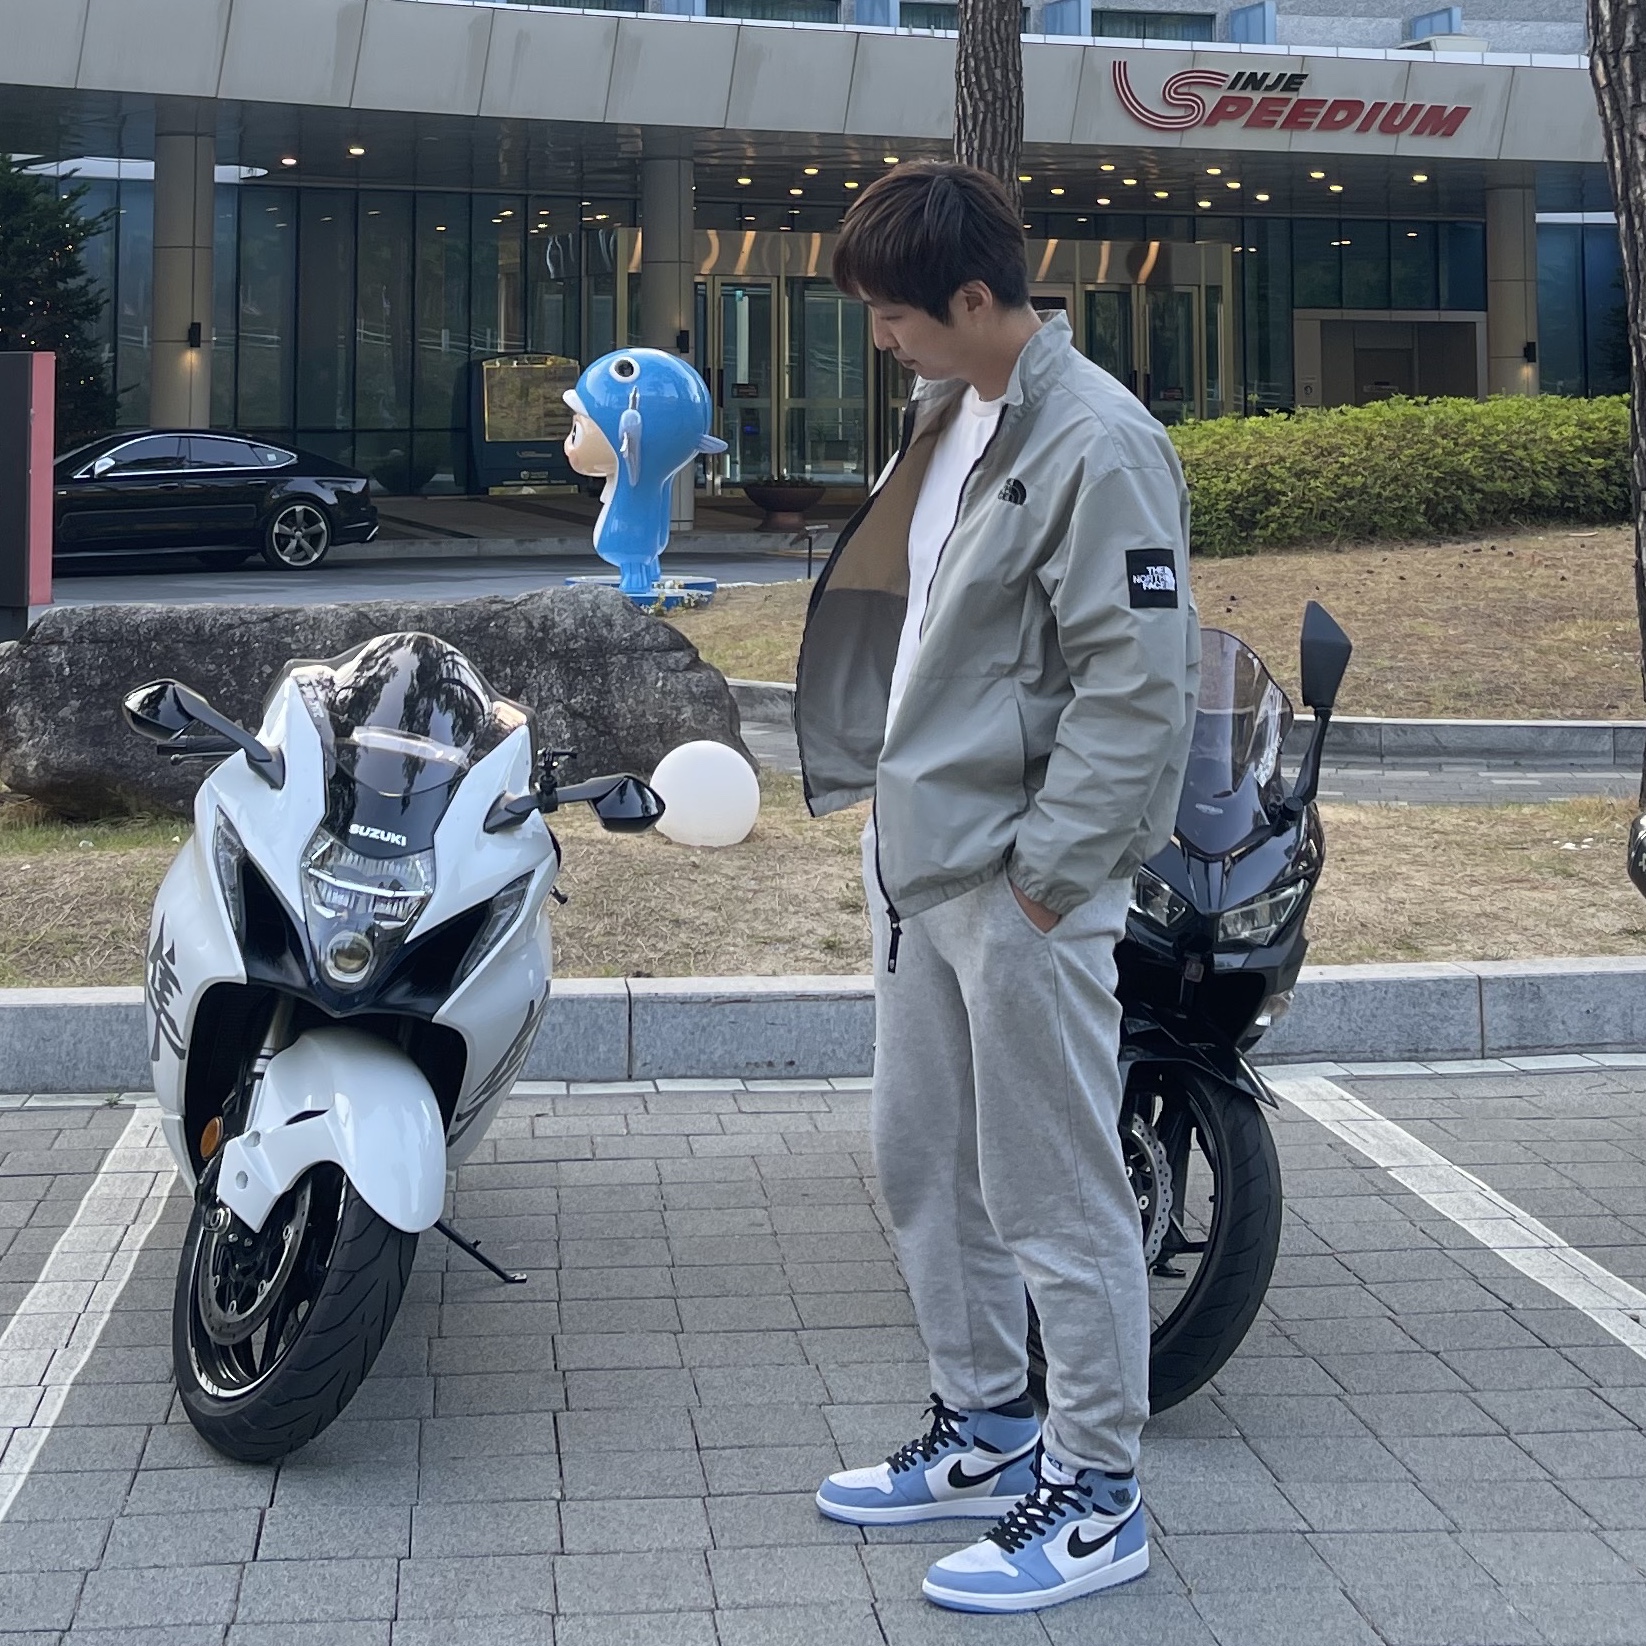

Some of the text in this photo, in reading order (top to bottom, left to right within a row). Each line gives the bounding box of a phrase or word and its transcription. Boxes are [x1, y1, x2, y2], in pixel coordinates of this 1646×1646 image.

[1227, 71, 1308, 92] INJE
[1146, 566, 1165, 576] THE
[1143, 581, 1165, 590] FACE
[348, 823, 407, 847] SUZUKI
